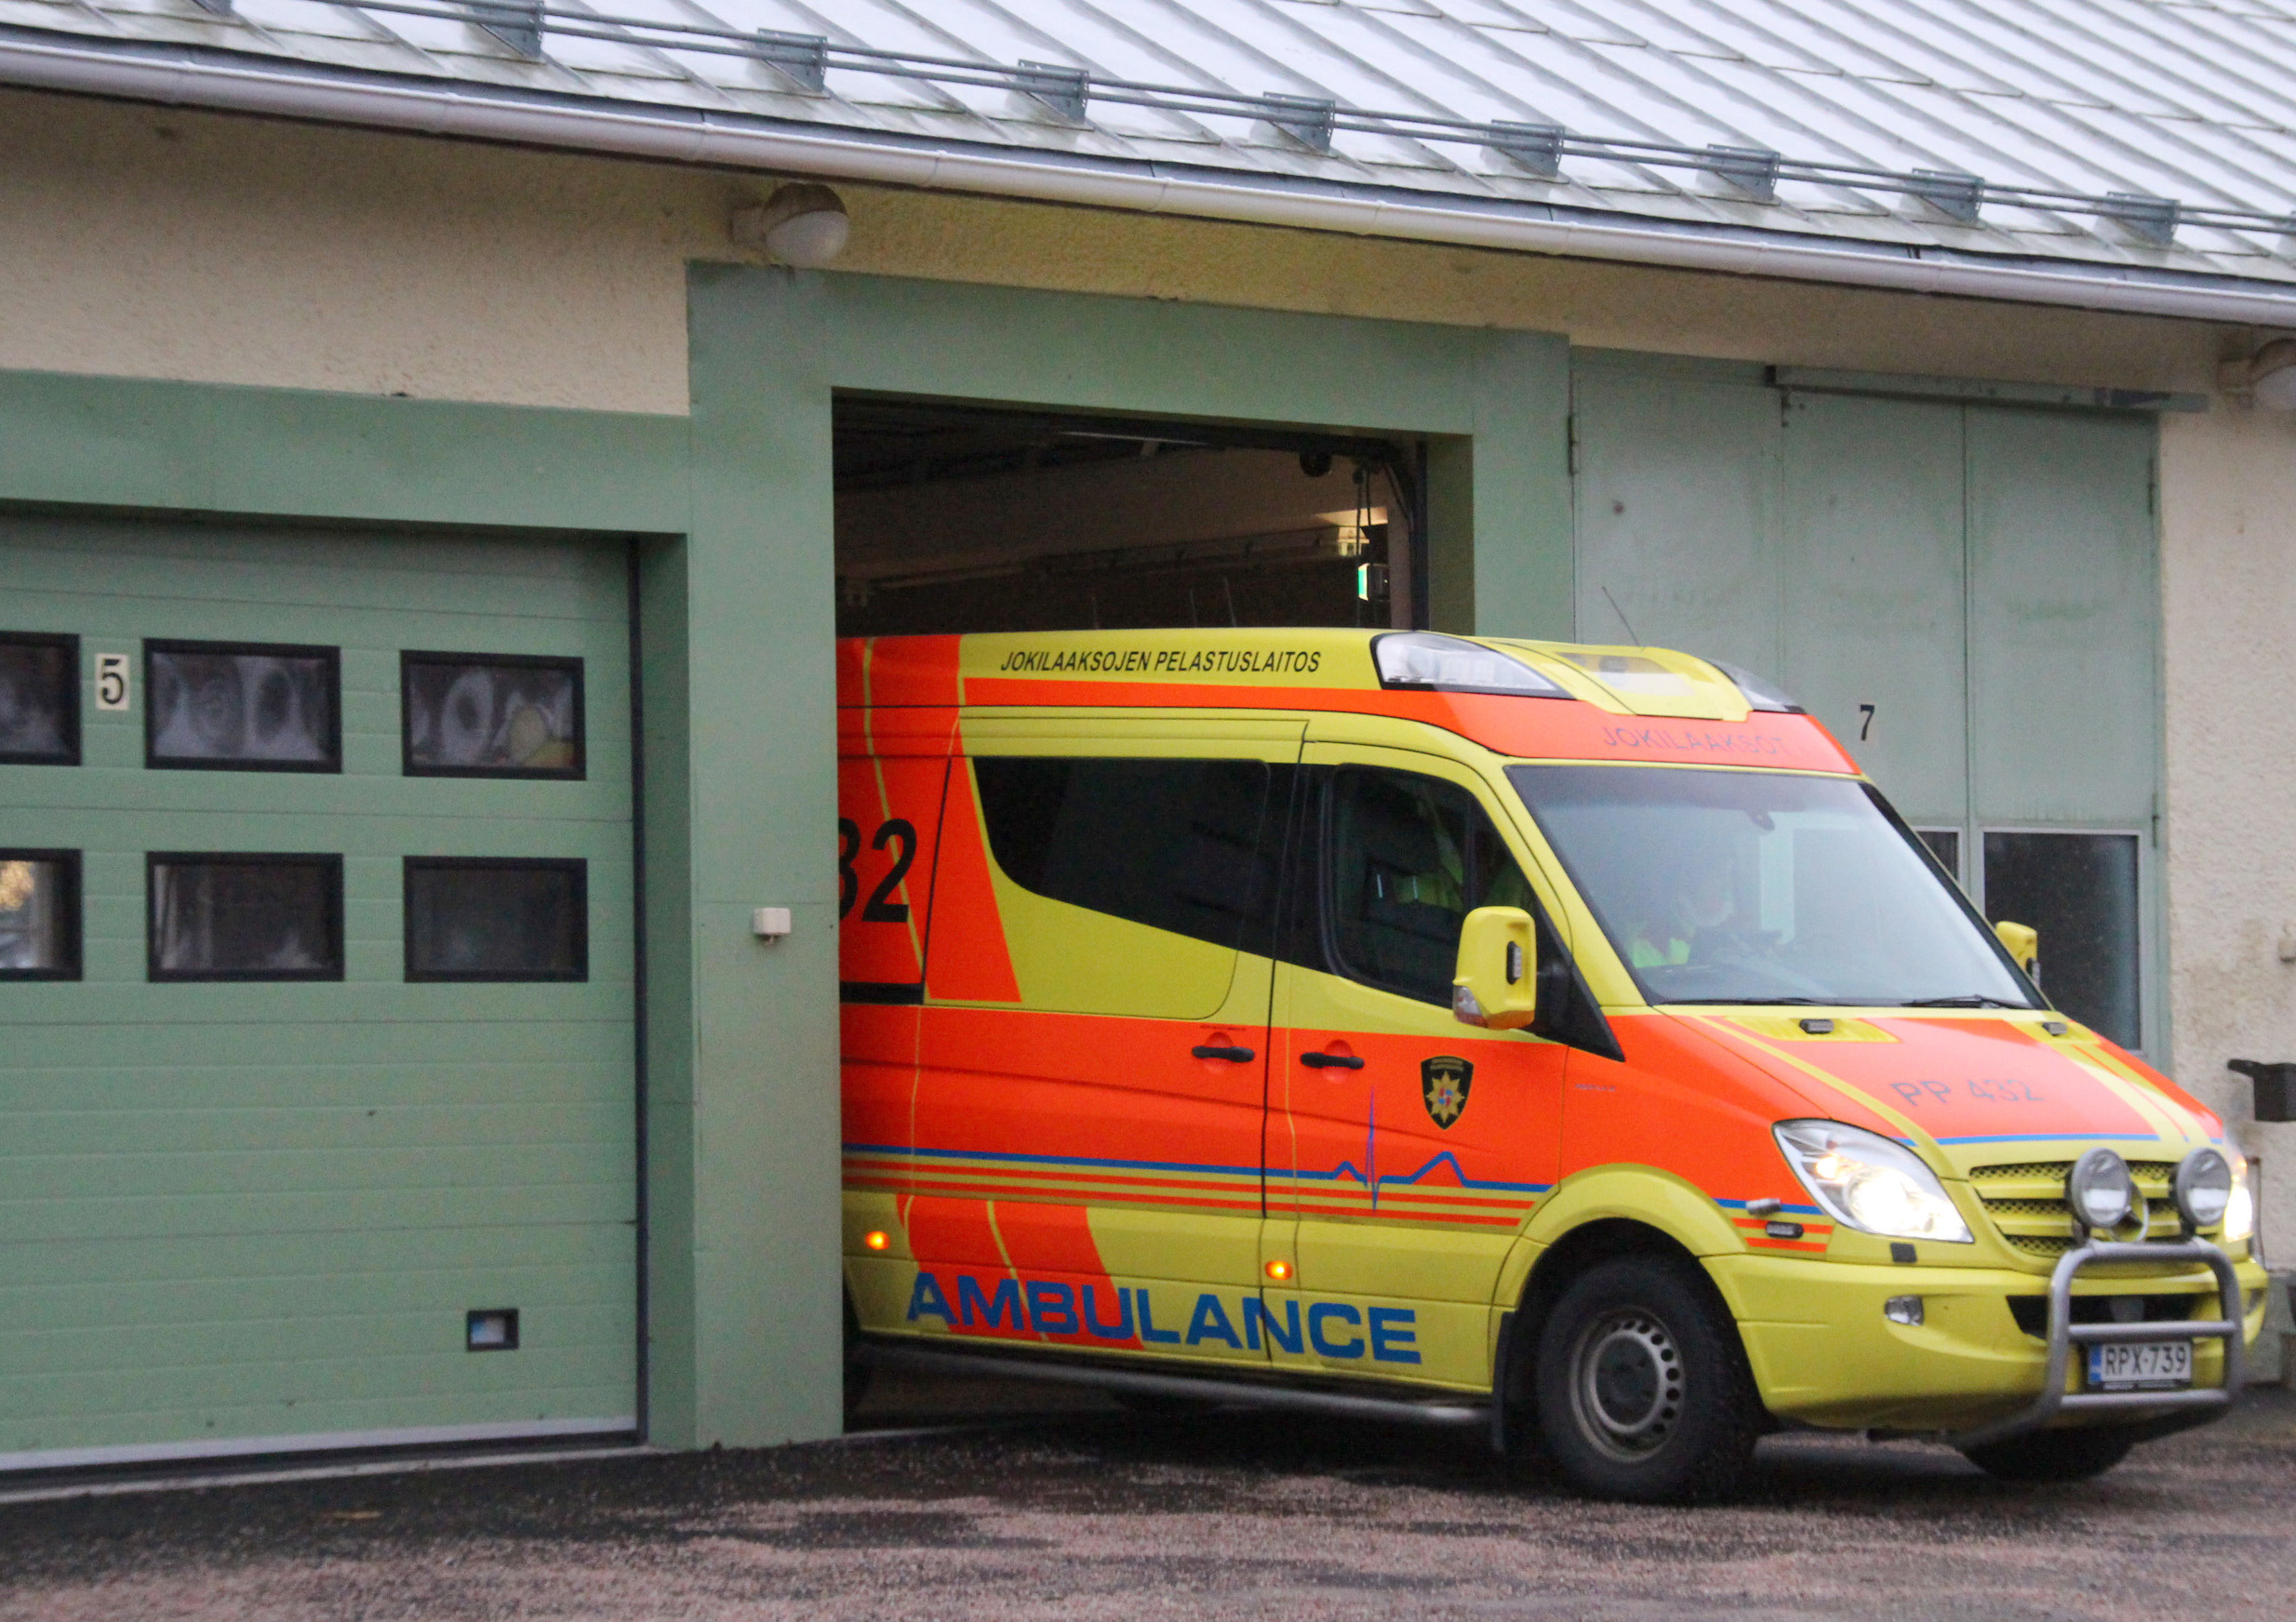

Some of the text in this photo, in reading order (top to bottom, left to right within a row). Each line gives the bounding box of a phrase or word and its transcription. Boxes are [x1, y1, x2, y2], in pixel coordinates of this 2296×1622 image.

[1001, 650, 1322, 673] JOKILAAKSOJEN PELASTUSLAITOS
[100, 658, 126, 706] 5
[1859, 704, 1876, 742] 7
[1889, 1079, 2045, 1107] PP 432
[907, 1271, 1422, 1365] AMBULANCE
[2104, 1345, 2187, 1376] RPX-739
